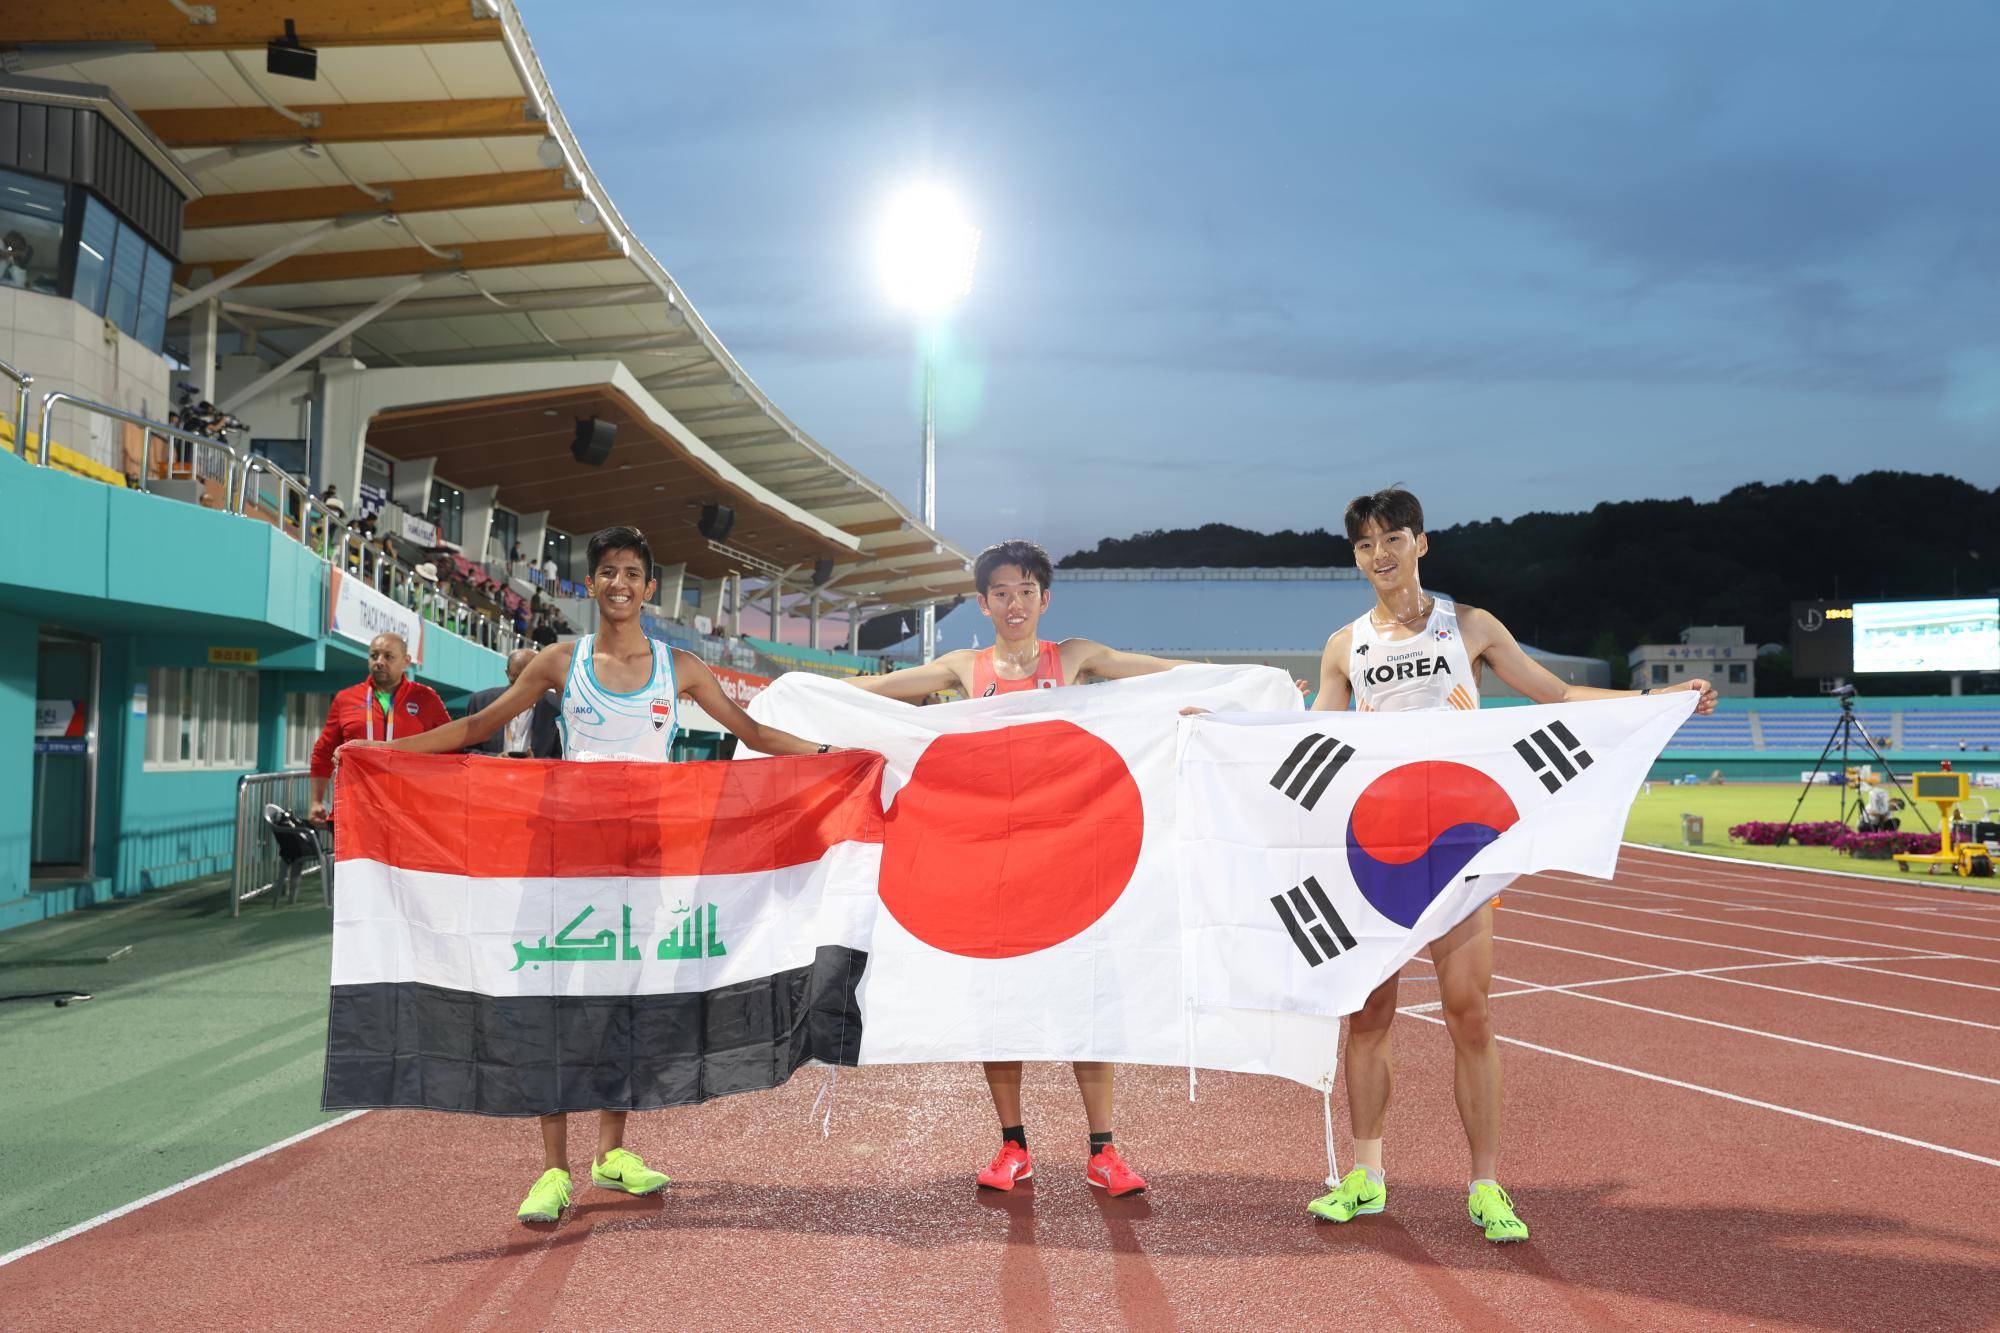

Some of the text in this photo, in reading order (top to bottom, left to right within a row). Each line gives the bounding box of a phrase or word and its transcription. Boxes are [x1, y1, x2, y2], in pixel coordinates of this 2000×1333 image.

[1386, 650, 1424, 662] Dunamu
[1363, 655, 1452, 687] KOREA
[573, 706, 592, 714] JAKO
